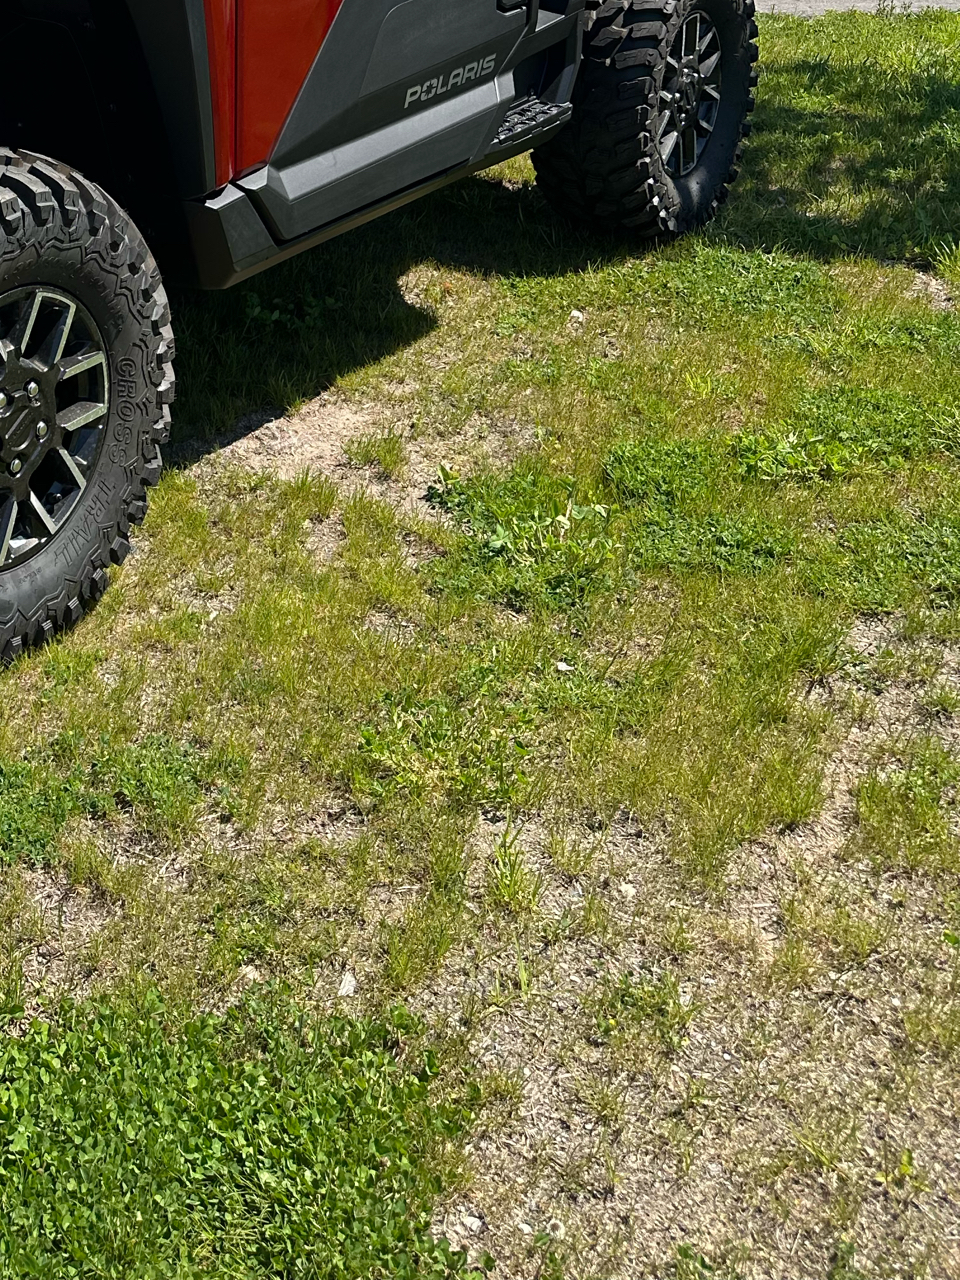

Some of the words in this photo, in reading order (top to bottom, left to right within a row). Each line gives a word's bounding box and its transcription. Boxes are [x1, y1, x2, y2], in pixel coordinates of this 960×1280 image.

[403, 53, 497, 109] POLARIS
[107, 357, 137, 467] CROSS
[53, 477, 118, 568] TRAIL
